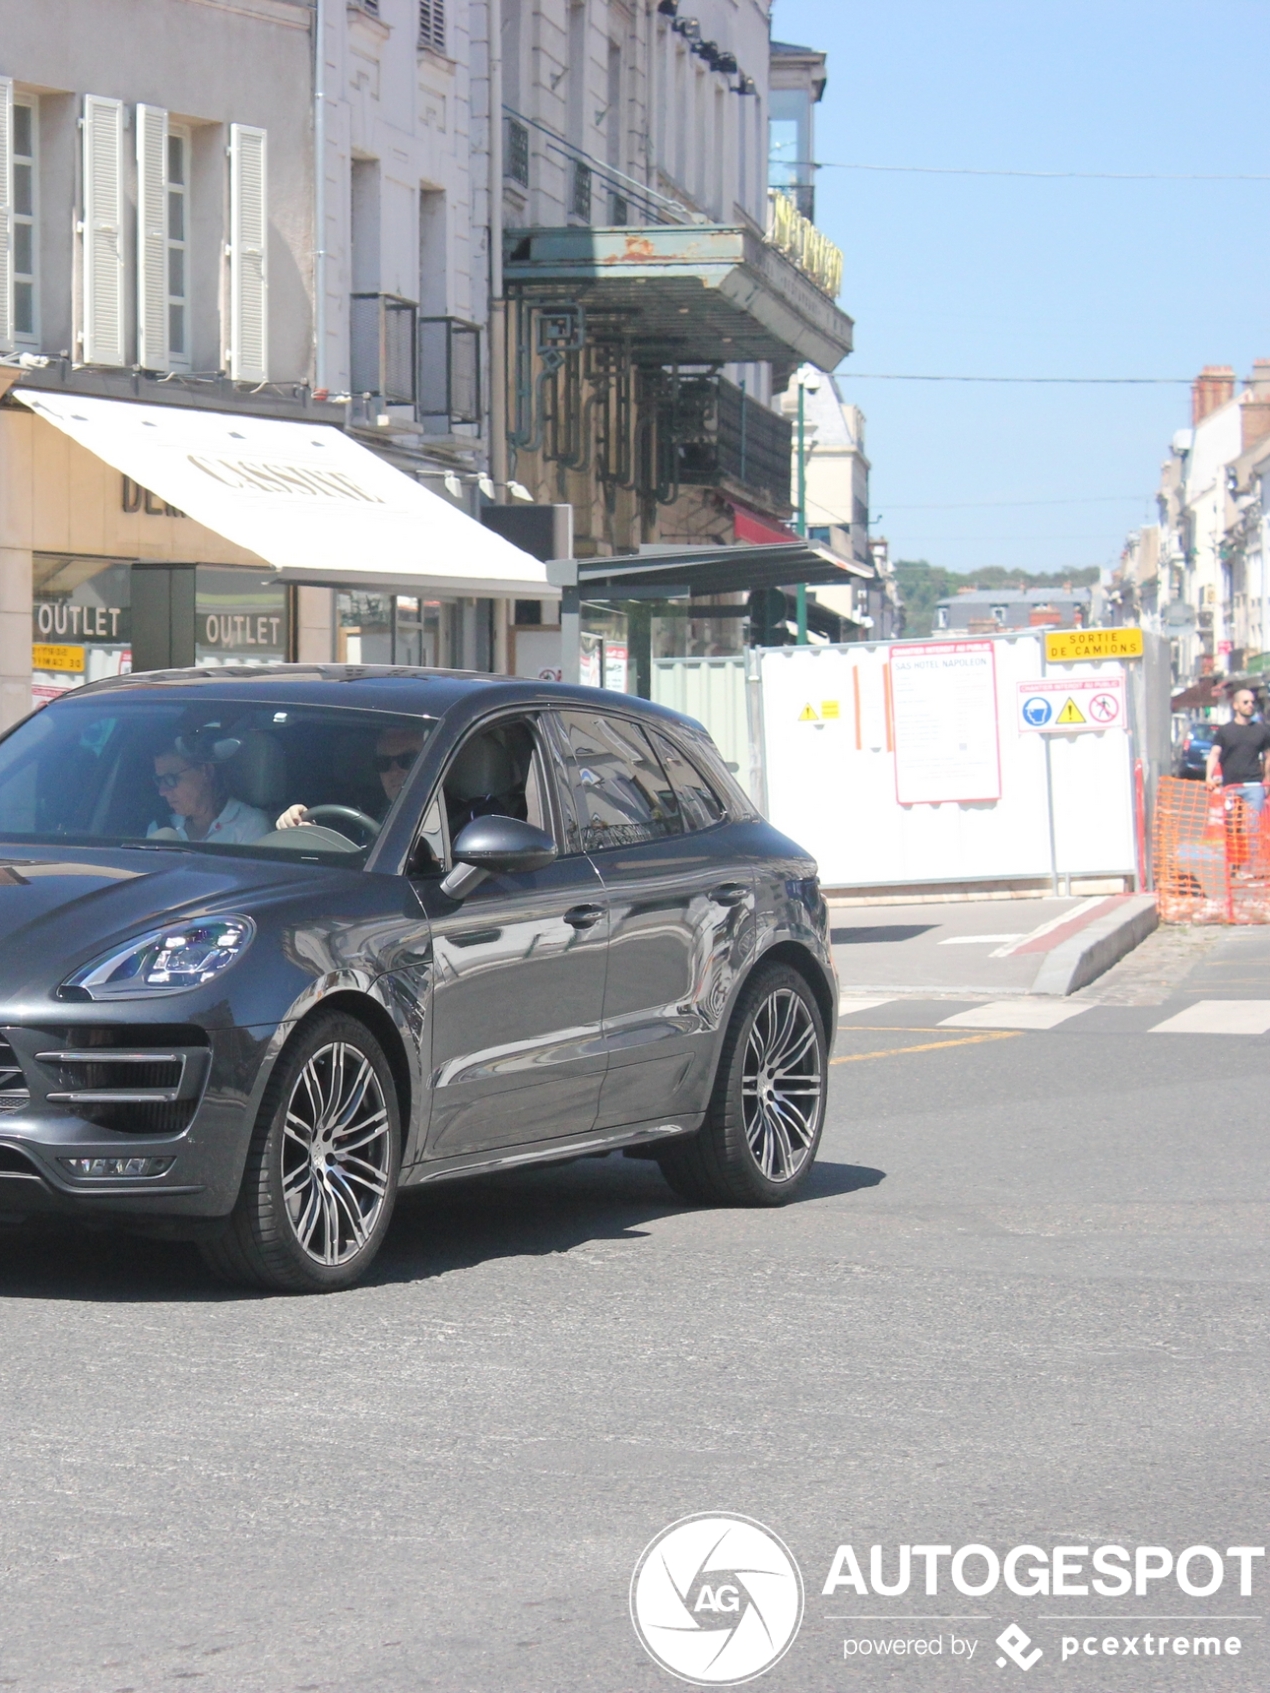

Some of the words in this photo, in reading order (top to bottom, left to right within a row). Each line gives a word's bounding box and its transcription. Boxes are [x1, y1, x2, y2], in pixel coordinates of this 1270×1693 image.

[187, 455, 386, 504] CASSINE
[38, 604, 121, 637] OUTLET
[205, 613, 280, 645] OUTLET
[1069, 632, 1118, 644] SORTIE
[1051, 647, 1067, 657] DE
[1075, 643, 1137, 656] CAMIONS
[895, 662, 912, 671] SAS
[914, 660, 939, 670] HOTEL
[942, 658, 987, 668] NAPOLEON
